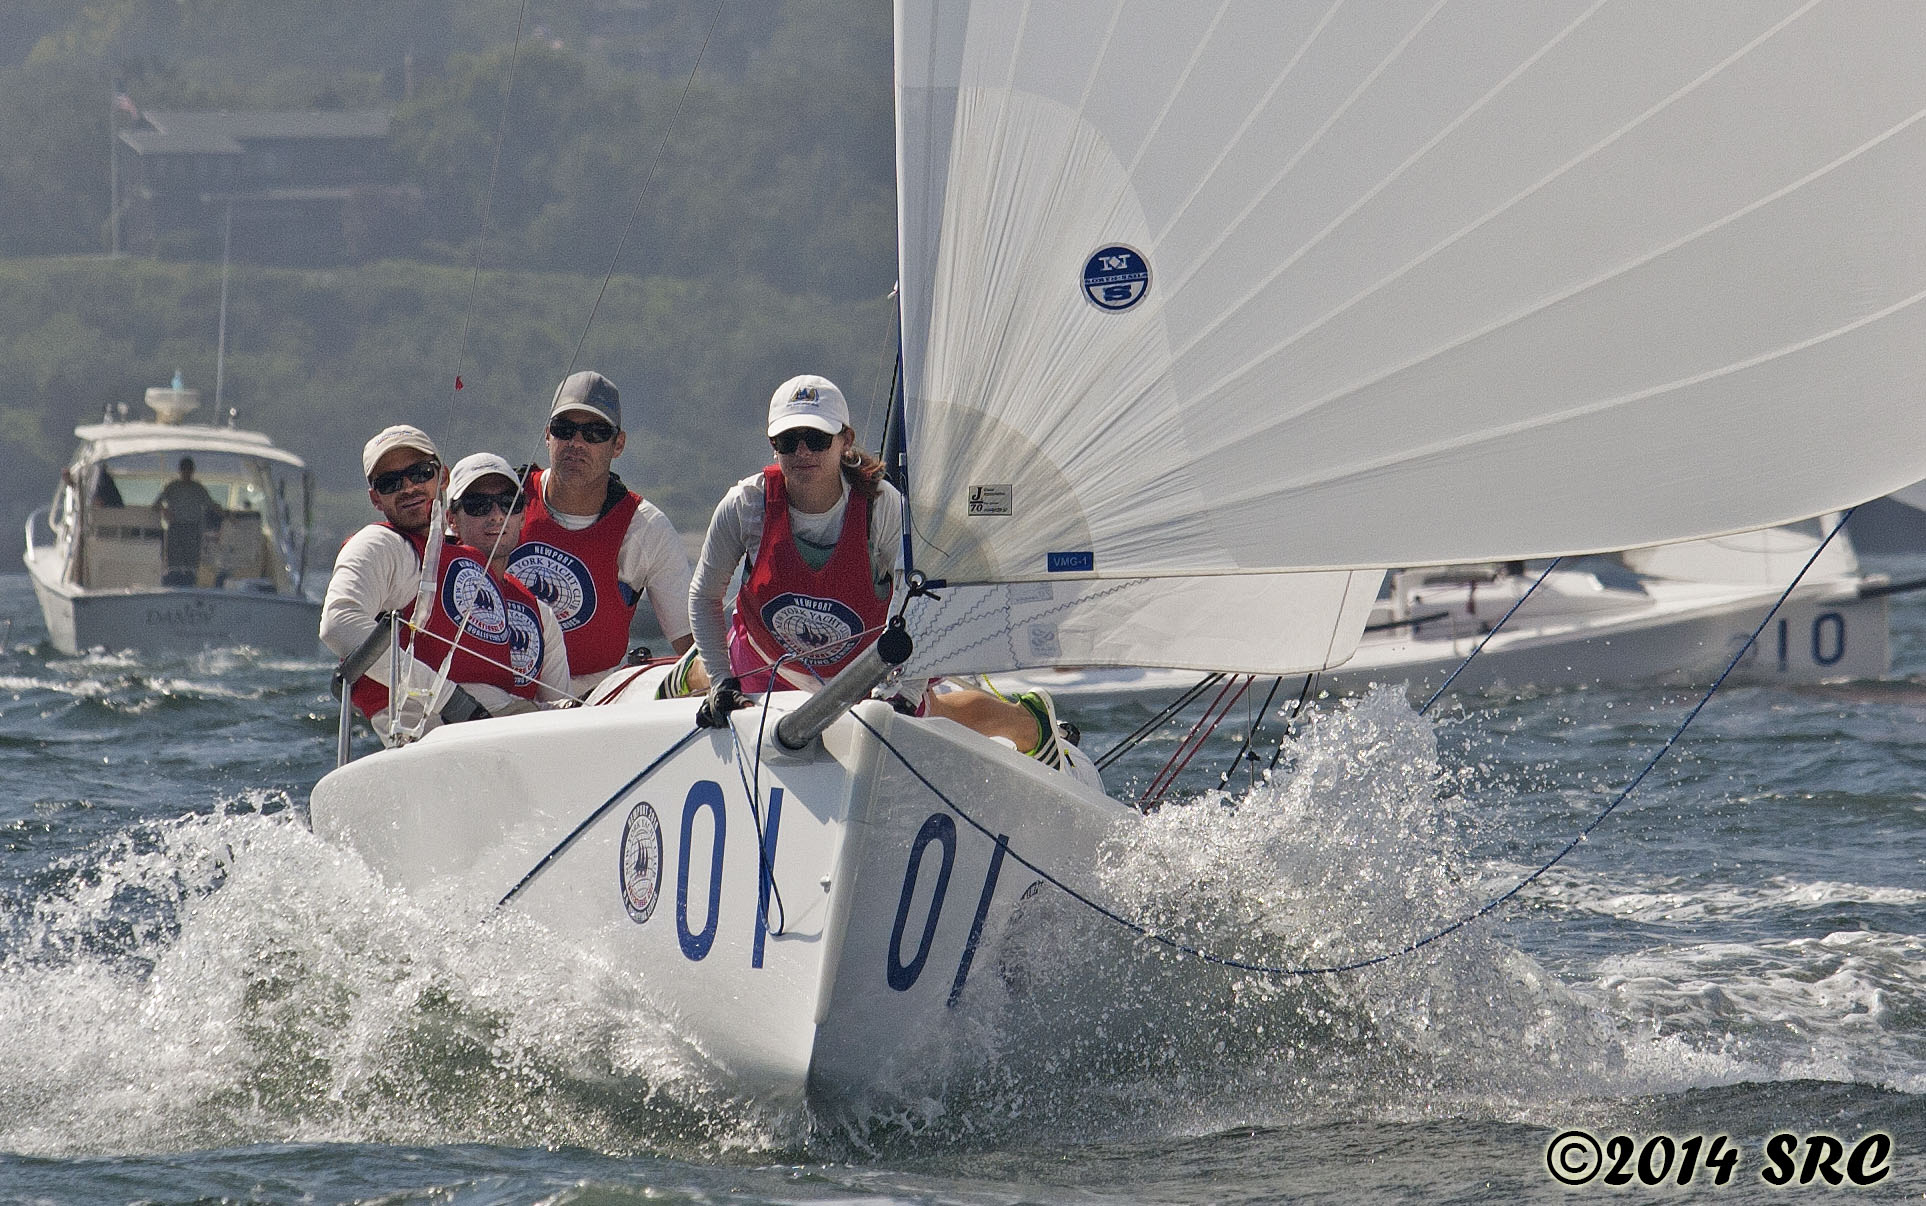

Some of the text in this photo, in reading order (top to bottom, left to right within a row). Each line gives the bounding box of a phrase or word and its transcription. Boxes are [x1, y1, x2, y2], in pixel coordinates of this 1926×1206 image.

[970, 504, 983, 513] 70
[534, 545, 574, 566] NEWPORT
[1053, 556, 1088, 568] VMG-1
[514, 557, 582, 610] YORK YACHT CLUB
[792, 597, 833, 612] NEWPORT
[809, 611, 842, 629] YACHT
[1777, 611, 1846, 673] 10
[886, 812, 1010, 1008] 01
